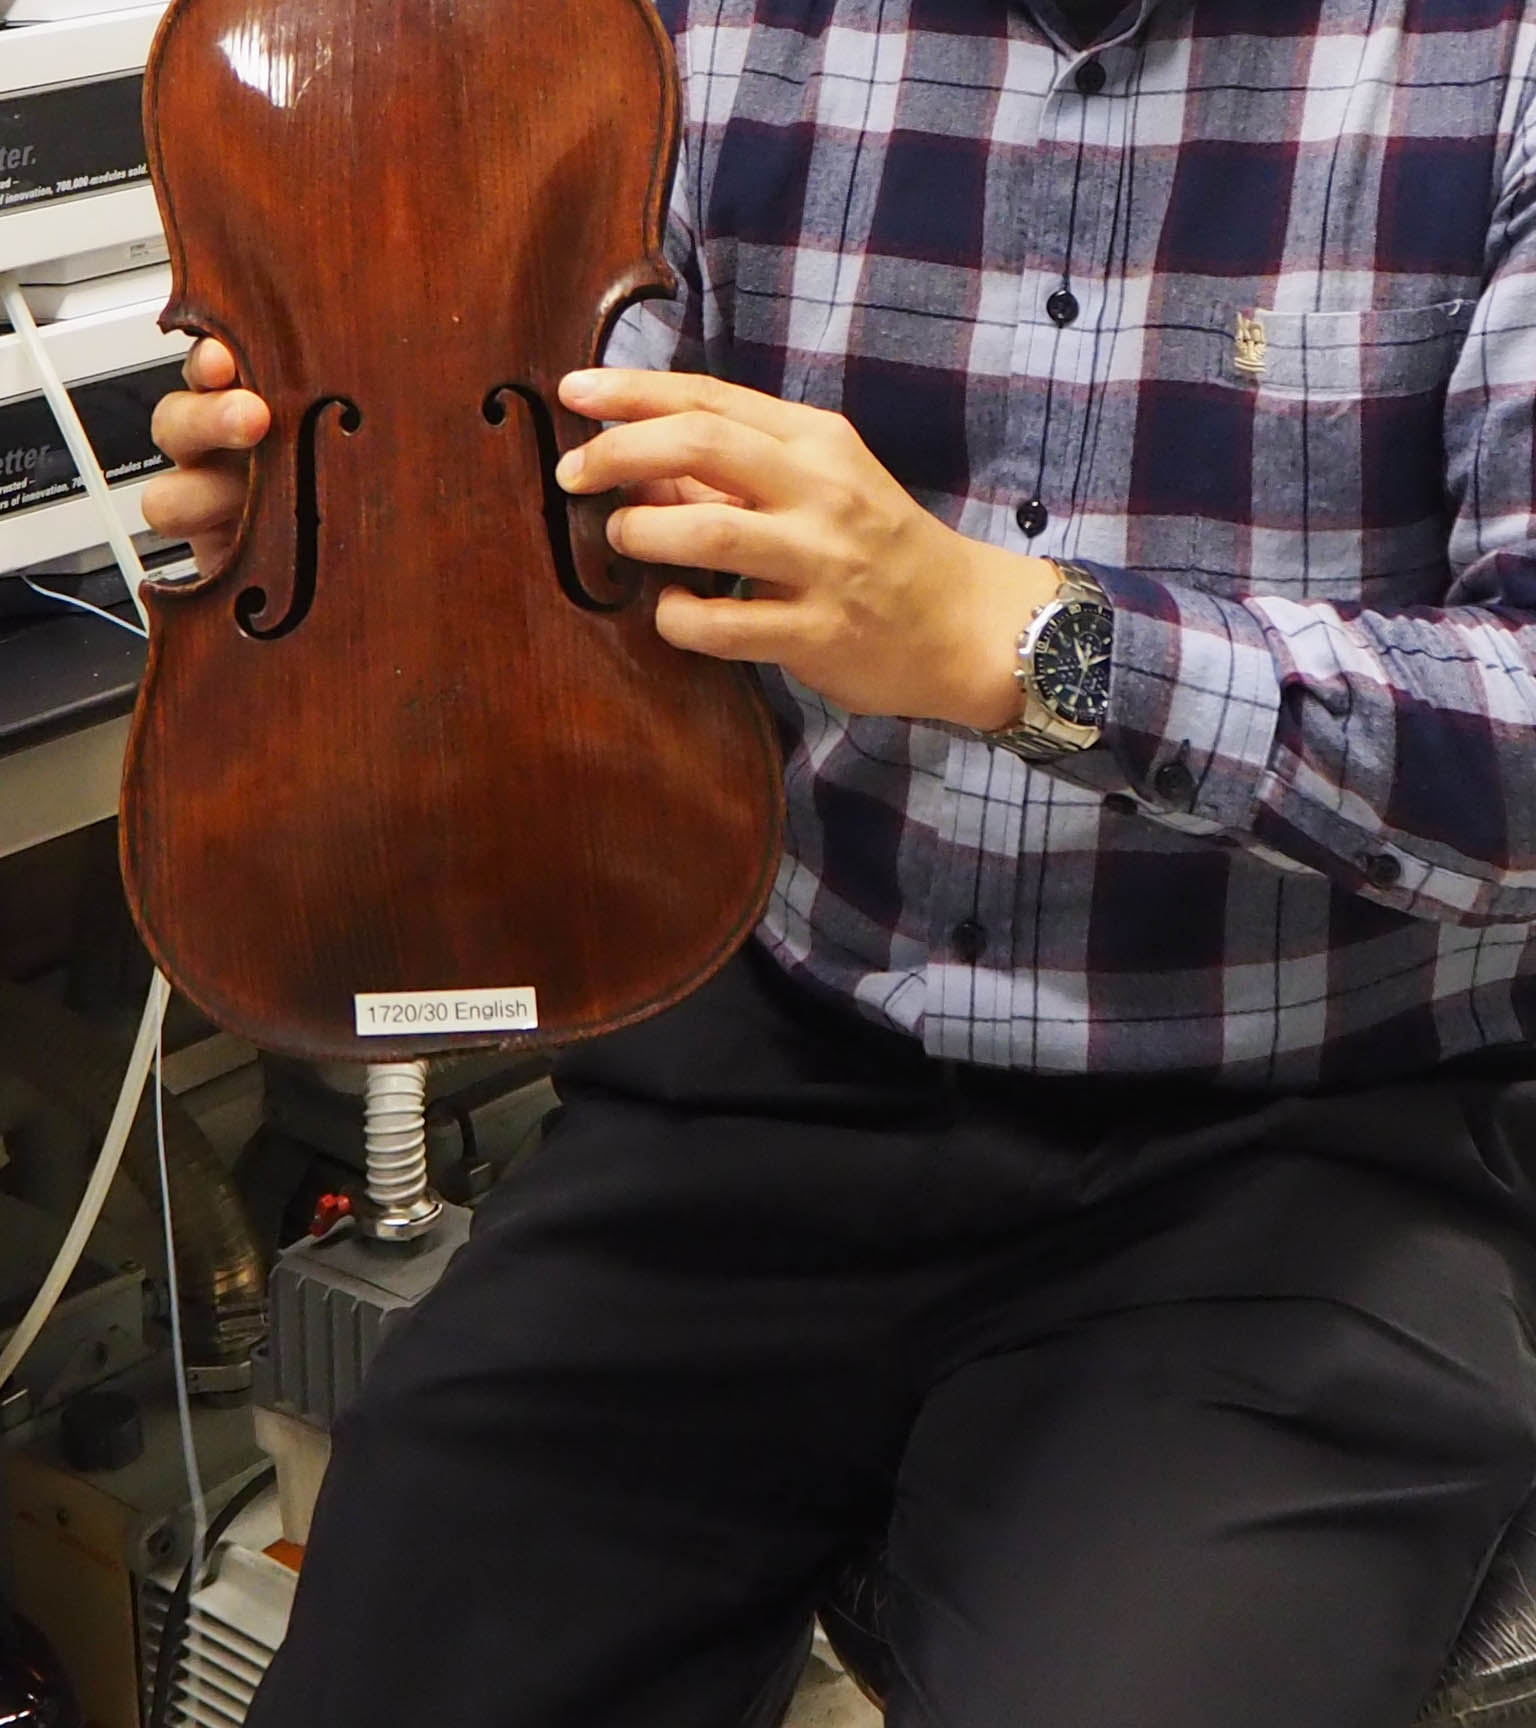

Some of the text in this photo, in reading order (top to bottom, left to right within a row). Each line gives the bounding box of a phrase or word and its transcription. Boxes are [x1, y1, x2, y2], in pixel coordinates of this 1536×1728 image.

[10, 495, 21, 507] of
[367, 1000, 527, 1024] 1720/30 English
